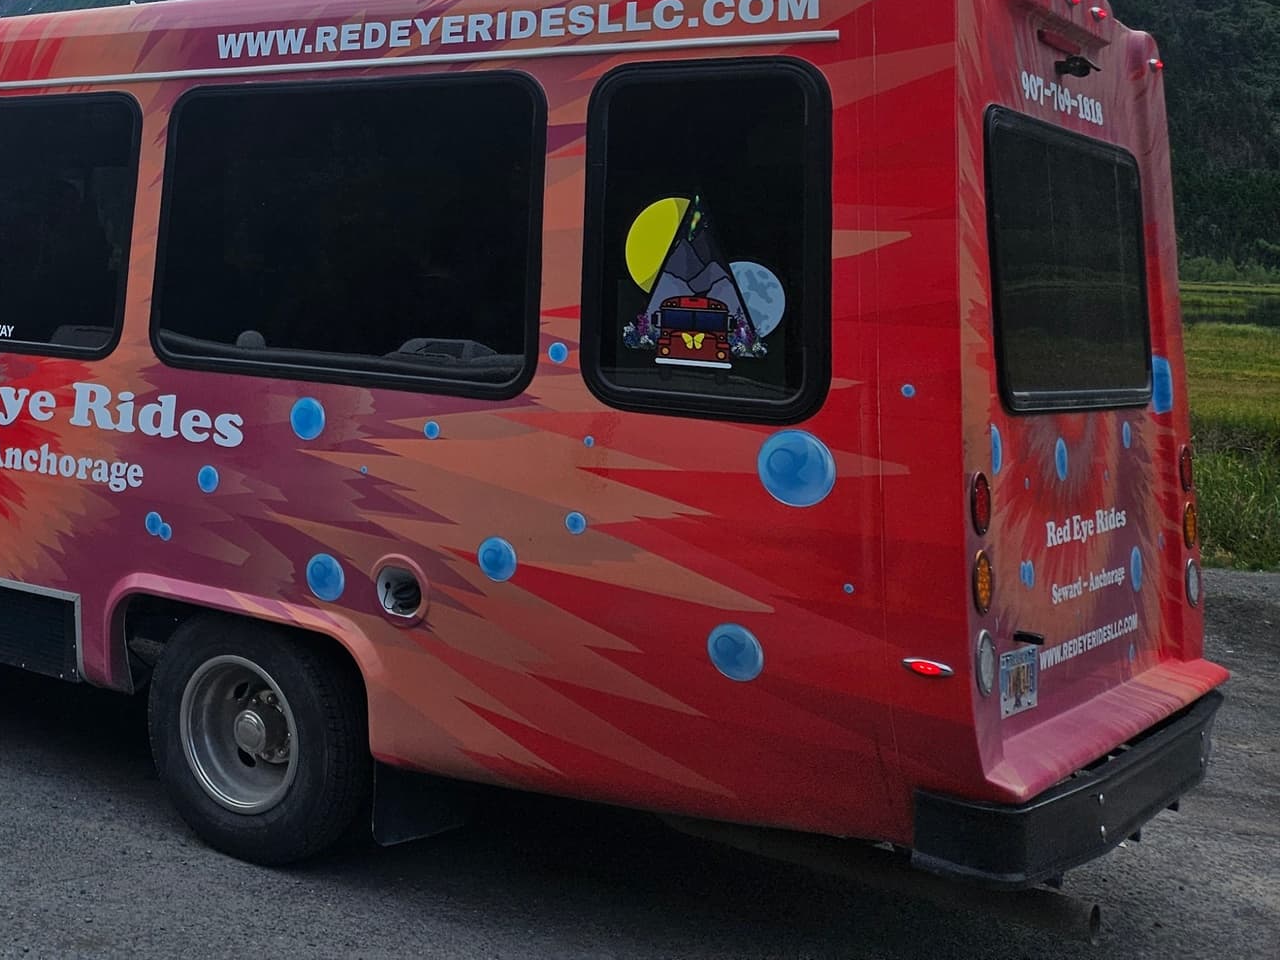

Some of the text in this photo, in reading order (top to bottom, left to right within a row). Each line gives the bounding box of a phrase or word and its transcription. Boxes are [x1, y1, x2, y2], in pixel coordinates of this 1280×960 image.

[1021, 70, 1104, 126] 907-769-1818
[71, 382, 244, 448] Rides
[1045, 507, 1127, 547] Red Eye Rides
[1051, 577, 1083, 604] Seward
[1089, 566, 1125, 592] Anchorage
[1039, 613, 1139, 671] WWW.REDEYERIDESLLC.COM
